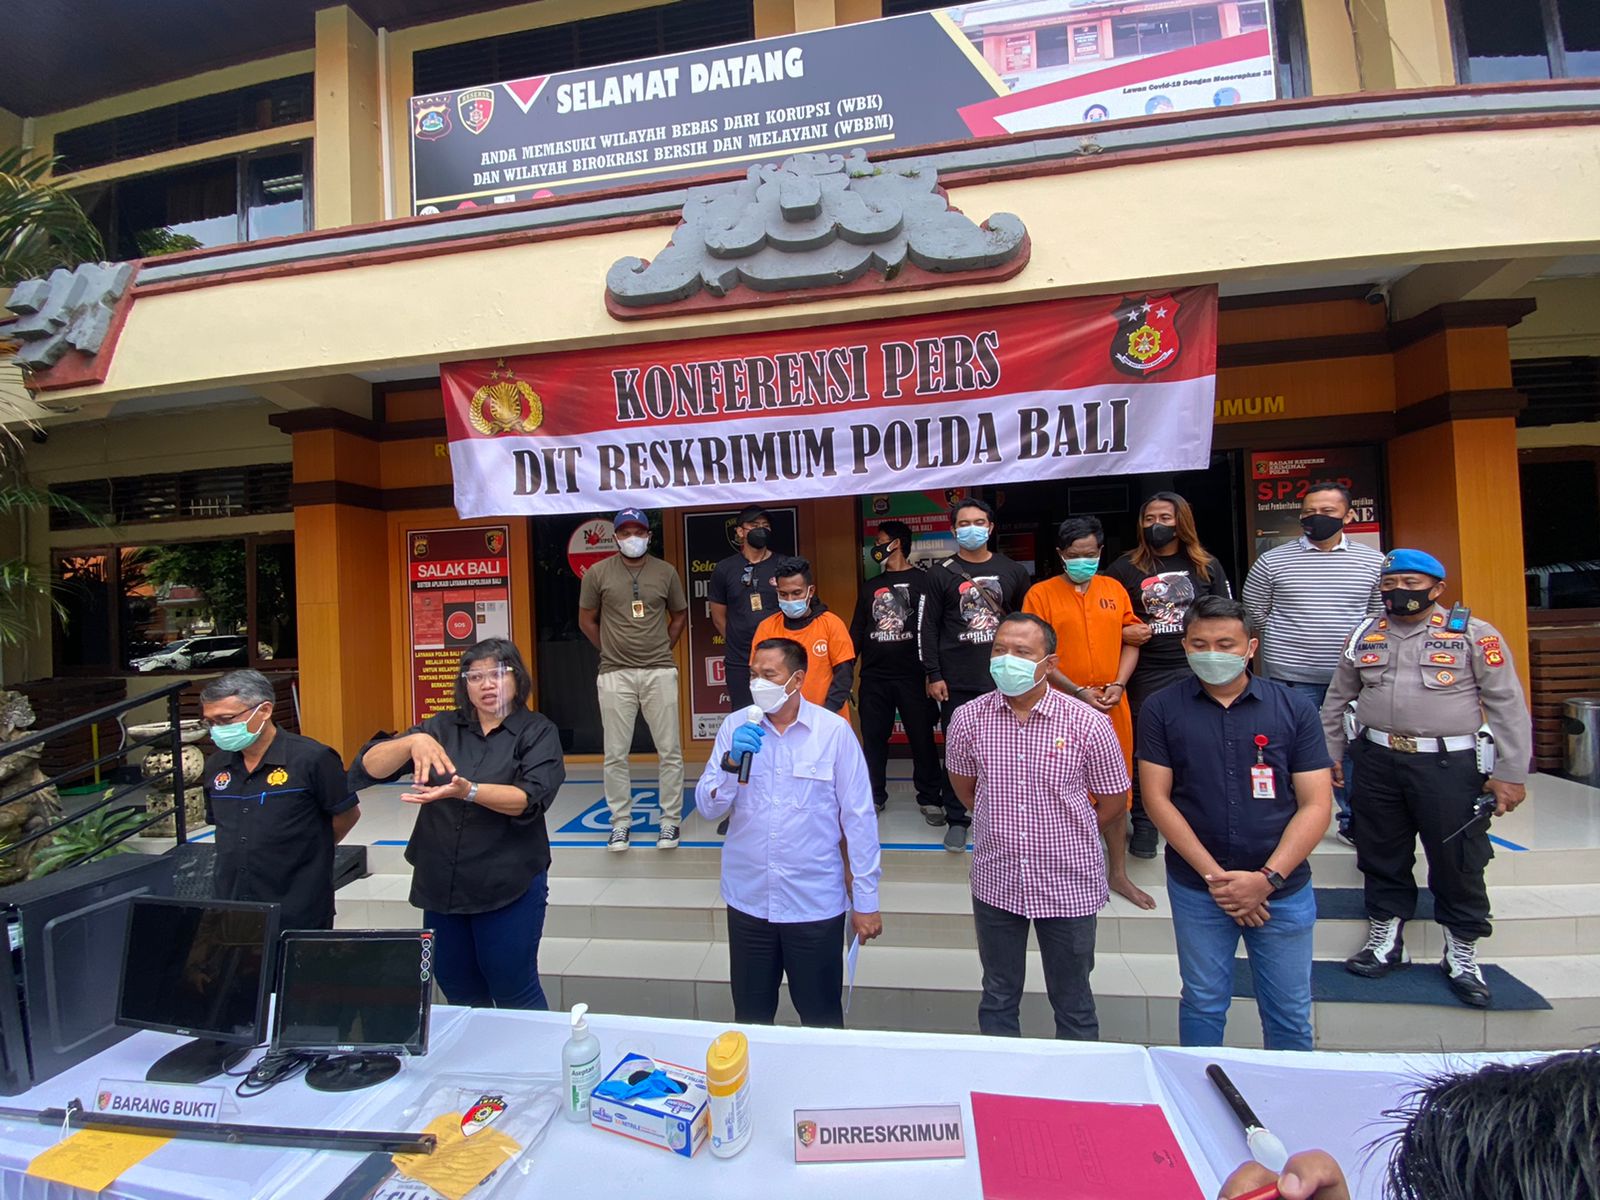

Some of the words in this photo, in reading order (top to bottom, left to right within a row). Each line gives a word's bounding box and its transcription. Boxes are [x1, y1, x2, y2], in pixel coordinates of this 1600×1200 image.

[557, 66, 679, 114] SELAMAT
[691, 47, 804, 93] DATANG
[1123, 86, 1147, 94] Lawan
[1149, 81, 1181, 90] Covid-19
[481, 148, 517, 165] ANDA
[522, 136, 596, 160] MEMASUKI
[600, 126, 666, 149] WILAYAH
[672, 118, 718, 138] BEBAS
[724, 112, 760, 131] DARI
[766, 102, 831, 125] KORUPSI
[836, 94, 883, 117] (WBK)
[473, 170, 500, 186] DAN
[504, 160, 567, 182] WILAYAH
[572, 149, 648, 173] BIROKRASI
[654, 141, 708, 161] BERSIH
[713, 135, 743, 153] DAN
[748, 123, 828, 147] MELAYANI
[834, 113, 894, 138] (WBBM)
[611, 344, 870, 422] KONFERENSI
[882, 329, 1001, 398] PERS
[513, 446, 582, 497] DIT
[596, 426, 838, 493] RESKRIMUM
[850, 411, 1003, 476] POLDA
[1017, 398, 1131, 461] BALI
[418, 563, 465, 578] SALAK
[468, 561, 500, 575] BALI
[1100, 598, 1117, 611] 05
[815, 644, 828, 653] 10
[1424, 641, 1464, 650] POLRI
[112, 1095, 170, 1114] BARANG
[173, 1099, 216, 1119] BUKTI
[820, 1122, 959, 1145] DIRRESKRIMUM
